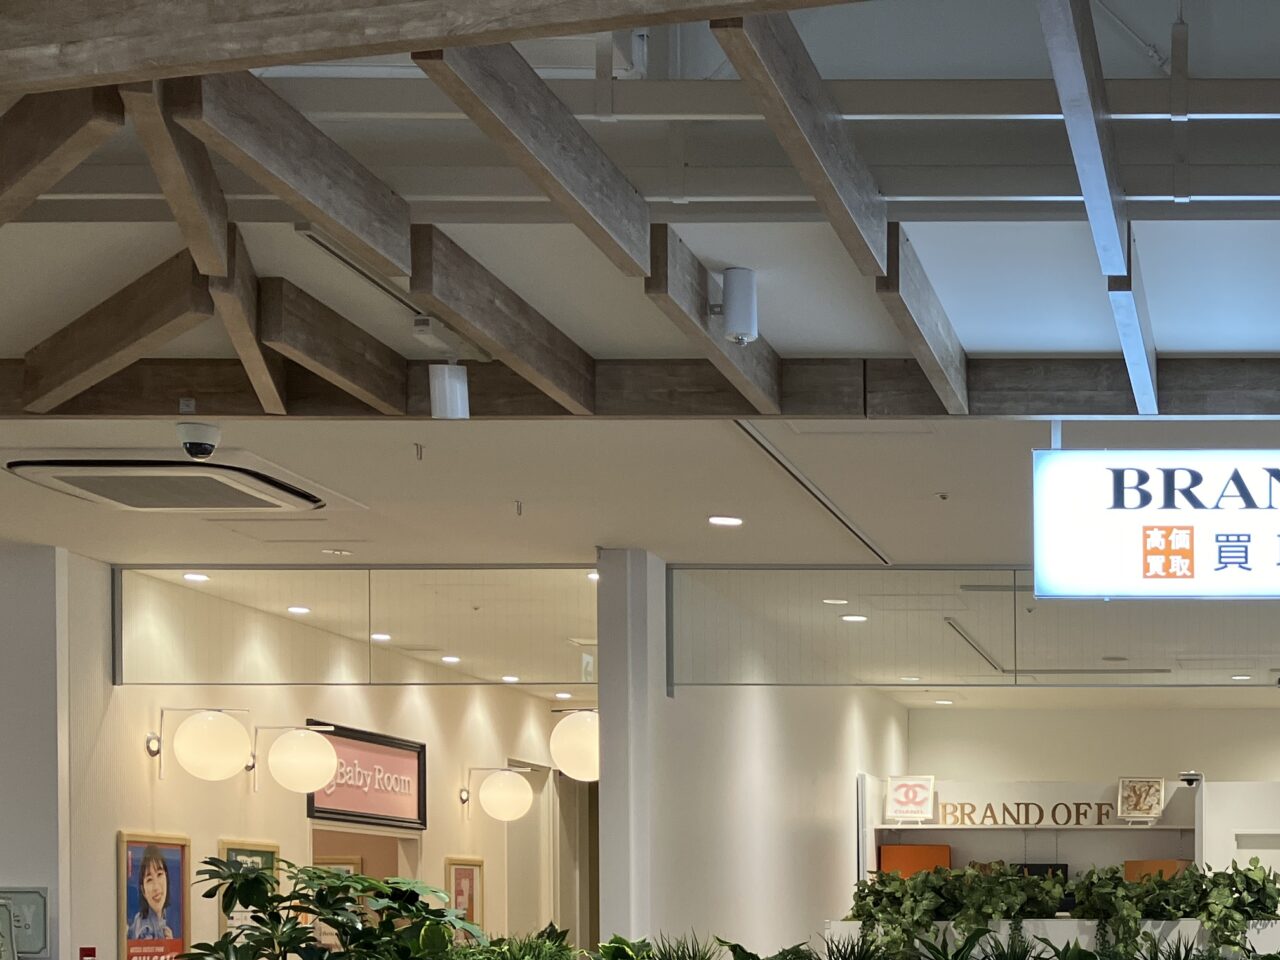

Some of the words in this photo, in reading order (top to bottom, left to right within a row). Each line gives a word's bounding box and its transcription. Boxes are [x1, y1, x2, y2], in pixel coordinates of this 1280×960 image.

[336, 758, 373, 793] Baby
[373, 764, 412, 794] Room
[939, 802, 1045, 826] BRAND
[1051, 802, 1115, 826] OFF
